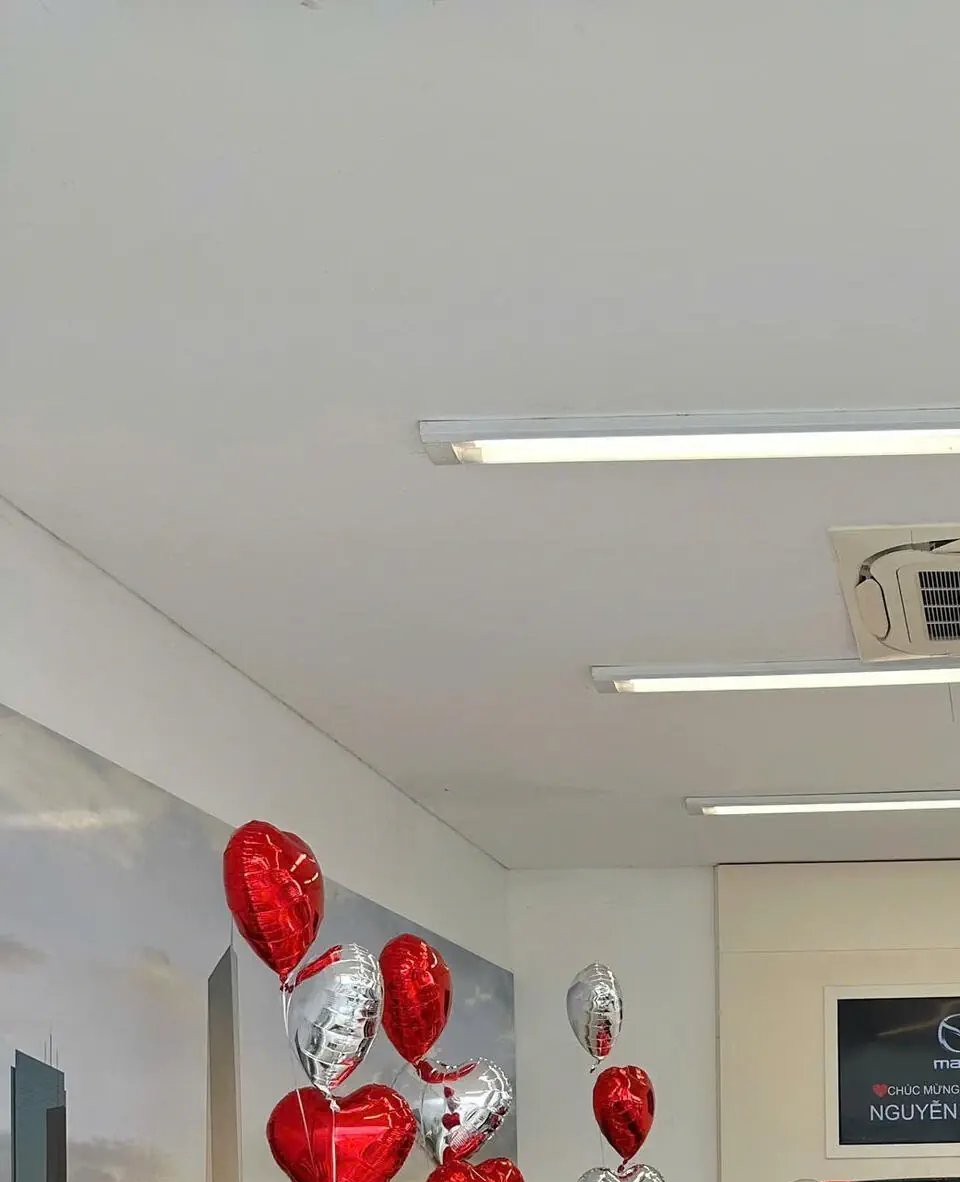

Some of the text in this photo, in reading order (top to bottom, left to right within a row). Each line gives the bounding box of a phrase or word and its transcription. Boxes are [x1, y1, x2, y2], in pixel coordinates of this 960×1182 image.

[887, 1084, 921, 1096] CHÚC
[923, 1080, 960, 1095] MỪNG
[870, 1100, 957, 1121] NGUYỄN
